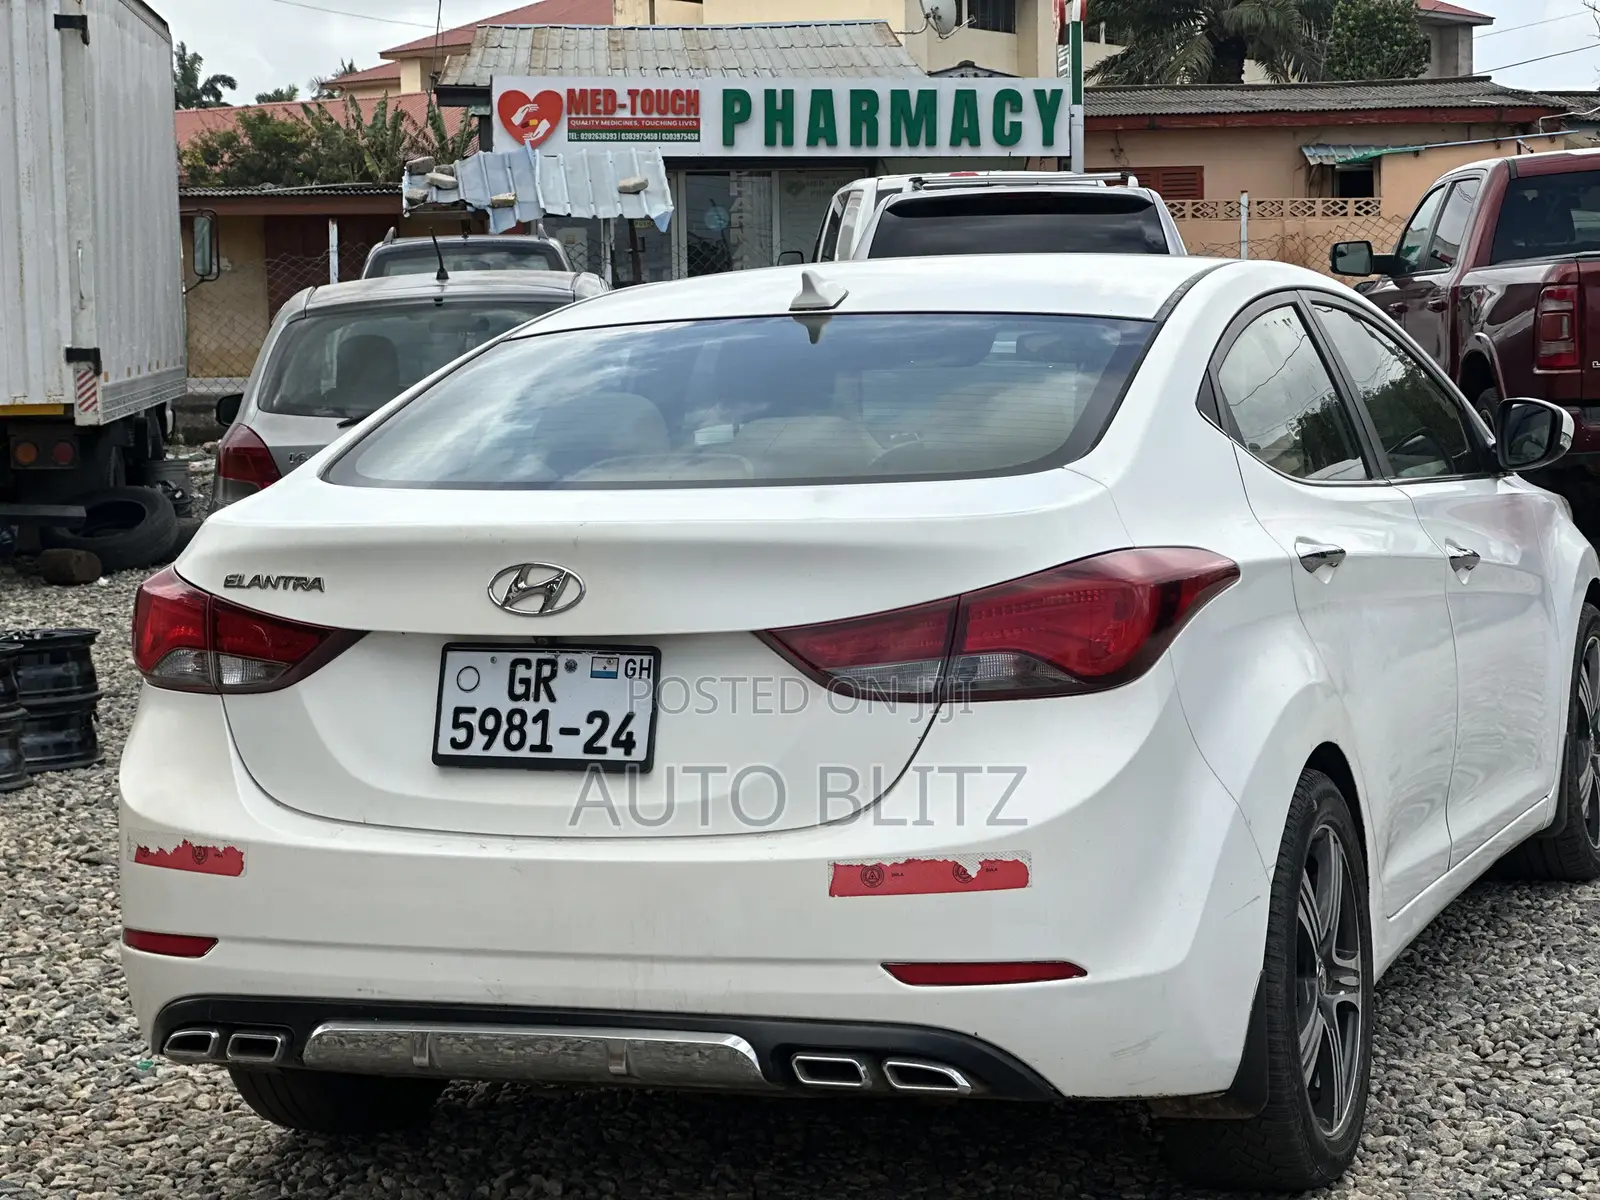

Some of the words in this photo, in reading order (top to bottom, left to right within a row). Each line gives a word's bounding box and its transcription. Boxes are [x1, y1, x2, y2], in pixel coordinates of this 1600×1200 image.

[566, 88, 700, 116] MED-TOUCH
[570, 119, 599, 127] QUALITY
[600, 119, 639, 127] MEDICINES,
[722, 88, 1064, 147] PHARMACY
[223, 574, 325, 593] ELANTRA
[508, 657, 559, 702] GR
[624, 658, 652, 680] GH
[450, 706, 637, 757] 5981-24
